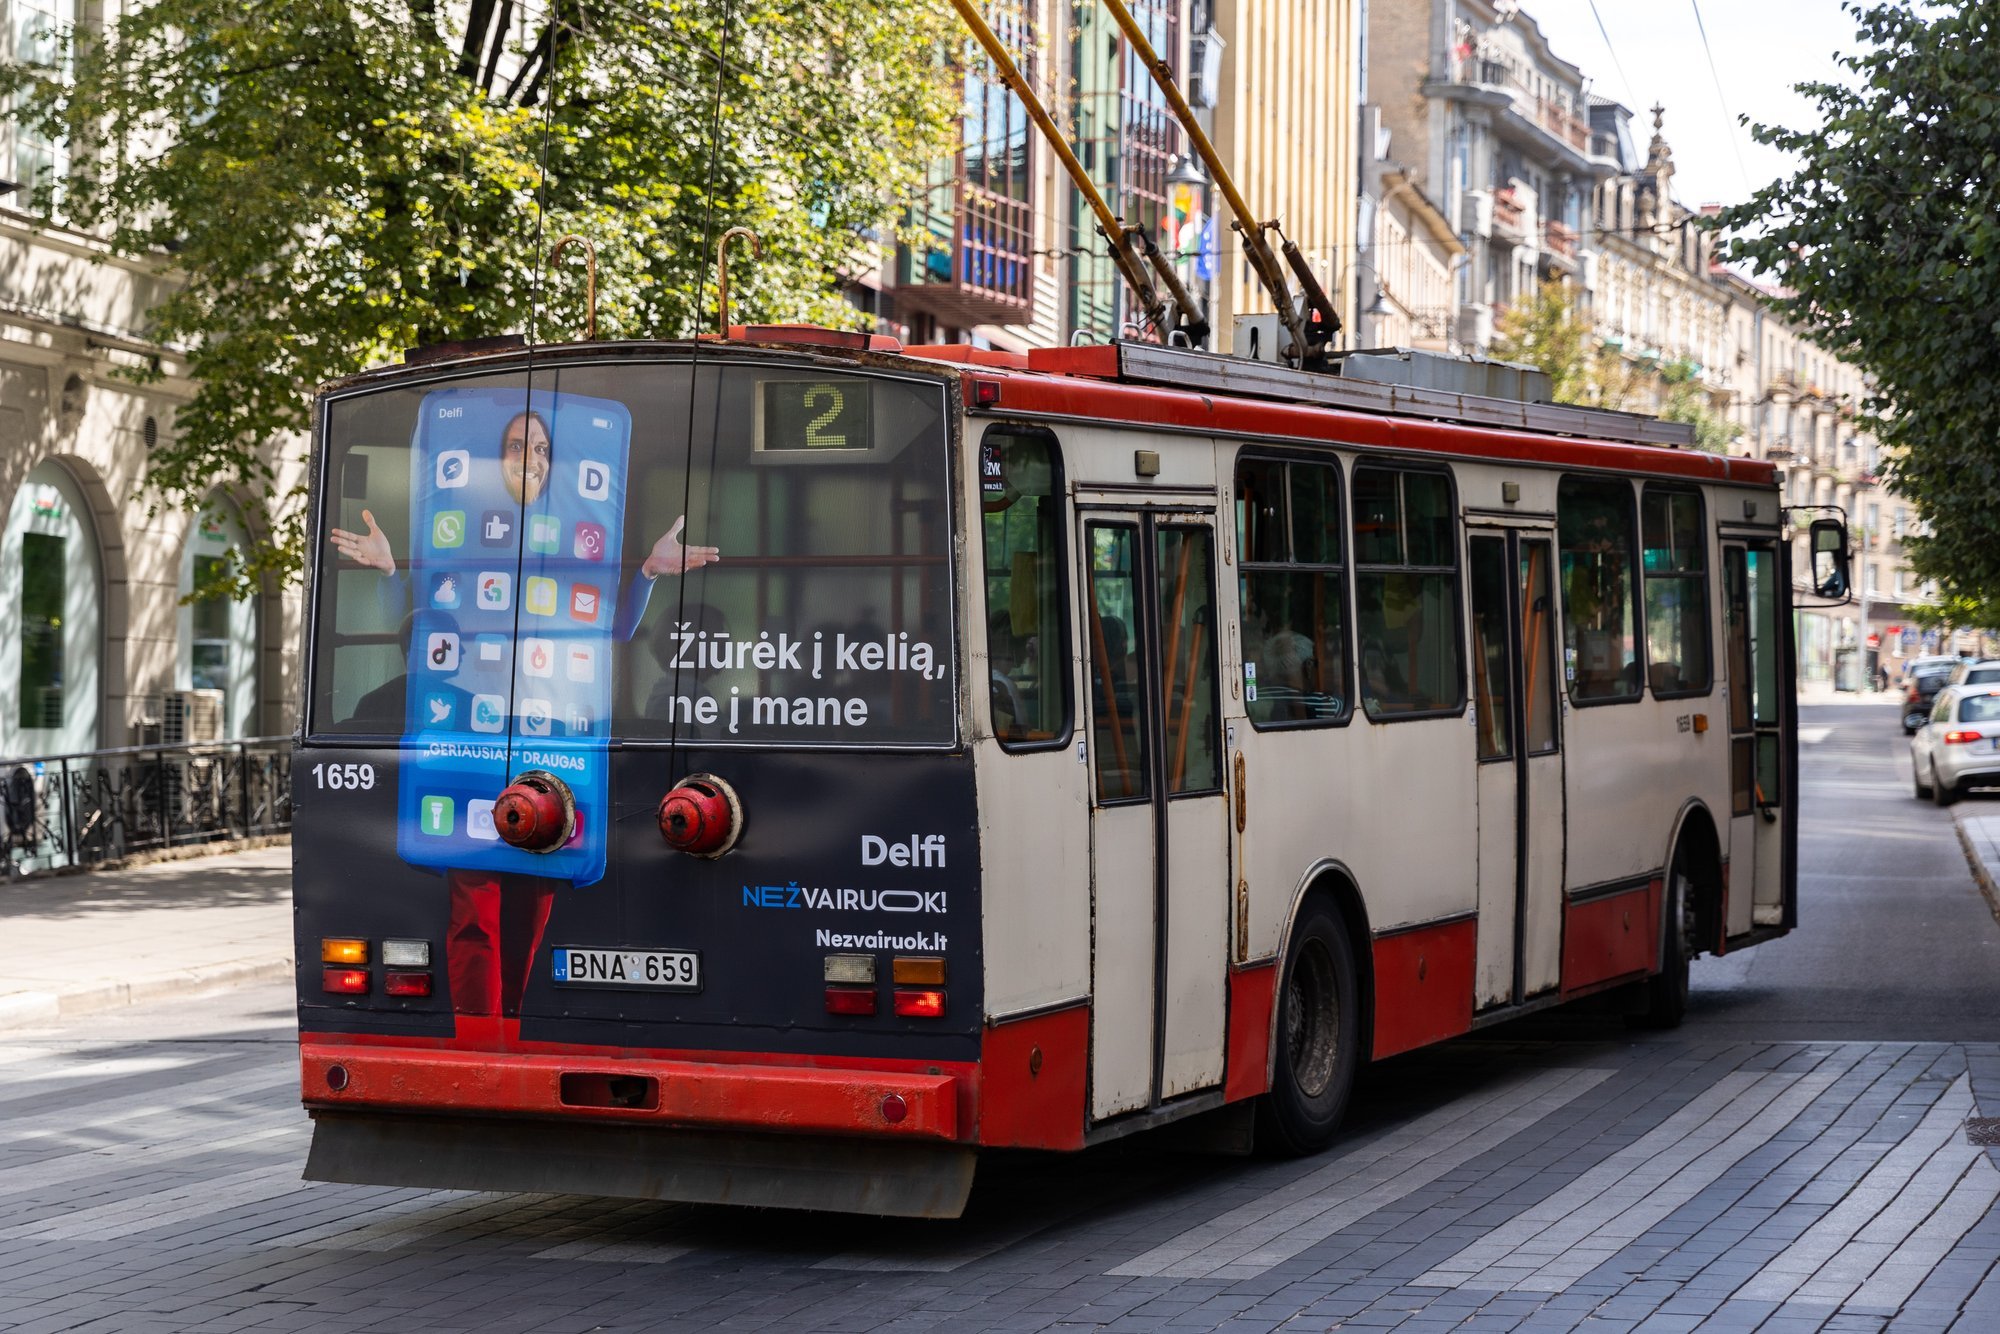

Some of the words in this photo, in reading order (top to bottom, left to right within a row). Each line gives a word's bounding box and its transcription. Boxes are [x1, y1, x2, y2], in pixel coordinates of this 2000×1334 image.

[439, 407, 463, 419] Delfi
[804, 383, 846, 446] 2
[669, 621, 802, 670] Žiūrėk
[812, 631, 823, 680] į
[836, 631, 946, 681] kelią,
[668, 695, 719, 725] ne
[729, 686, 739, 734] į
[753, 696, 868, 726] mane
[522, 751, 585, 770] DRAUGAS
[312, 763, 375, 790] 1659
[861, 834, 946, 868] Delfi
[816, 928, 948, 951] Nezvairuok.lt
[555, 968, 566, 976] LT
[570, 953, 627, 980] BNA
[645, 955, 693, 983] 659
